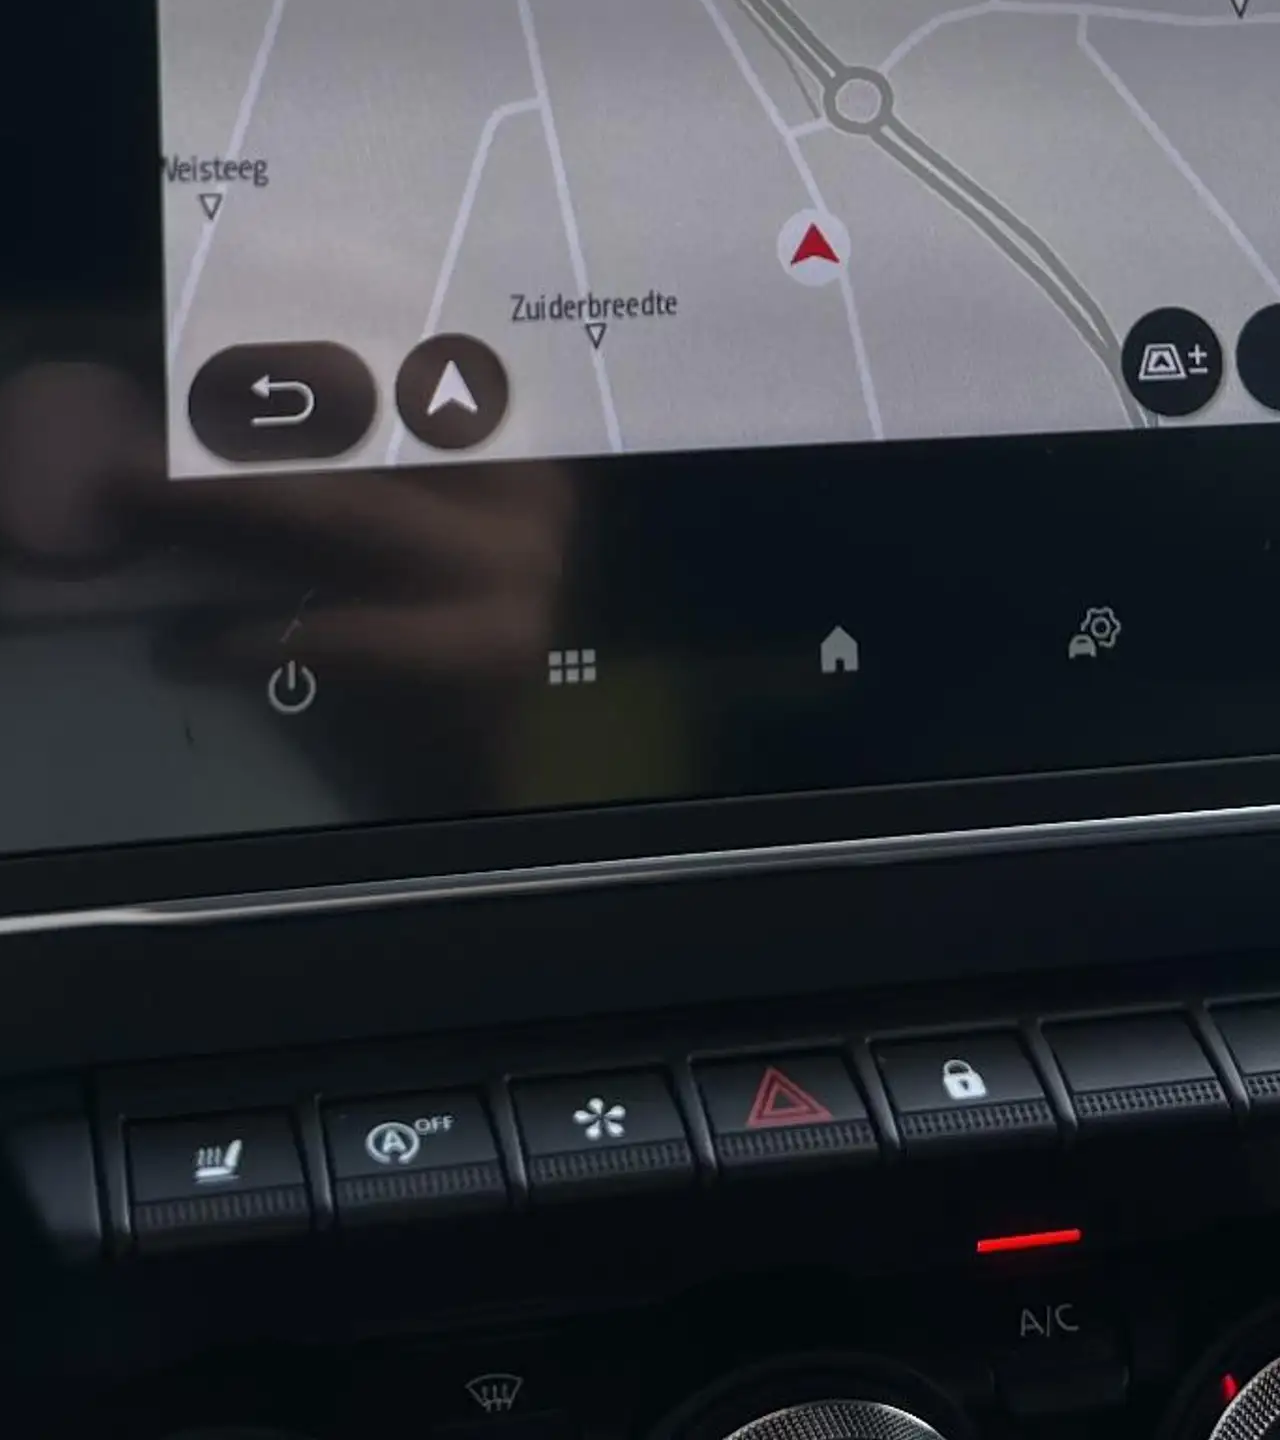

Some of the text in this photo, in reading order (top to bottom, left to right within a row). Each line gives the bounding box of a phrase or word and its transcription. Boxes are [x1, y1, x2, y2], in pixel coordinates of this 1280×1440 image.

[511, 292, 677, 321] Zuiderbreedte
[414, 1115, 454, 1135] OFF
[1019, 1303, 1080, 1337] A/C
